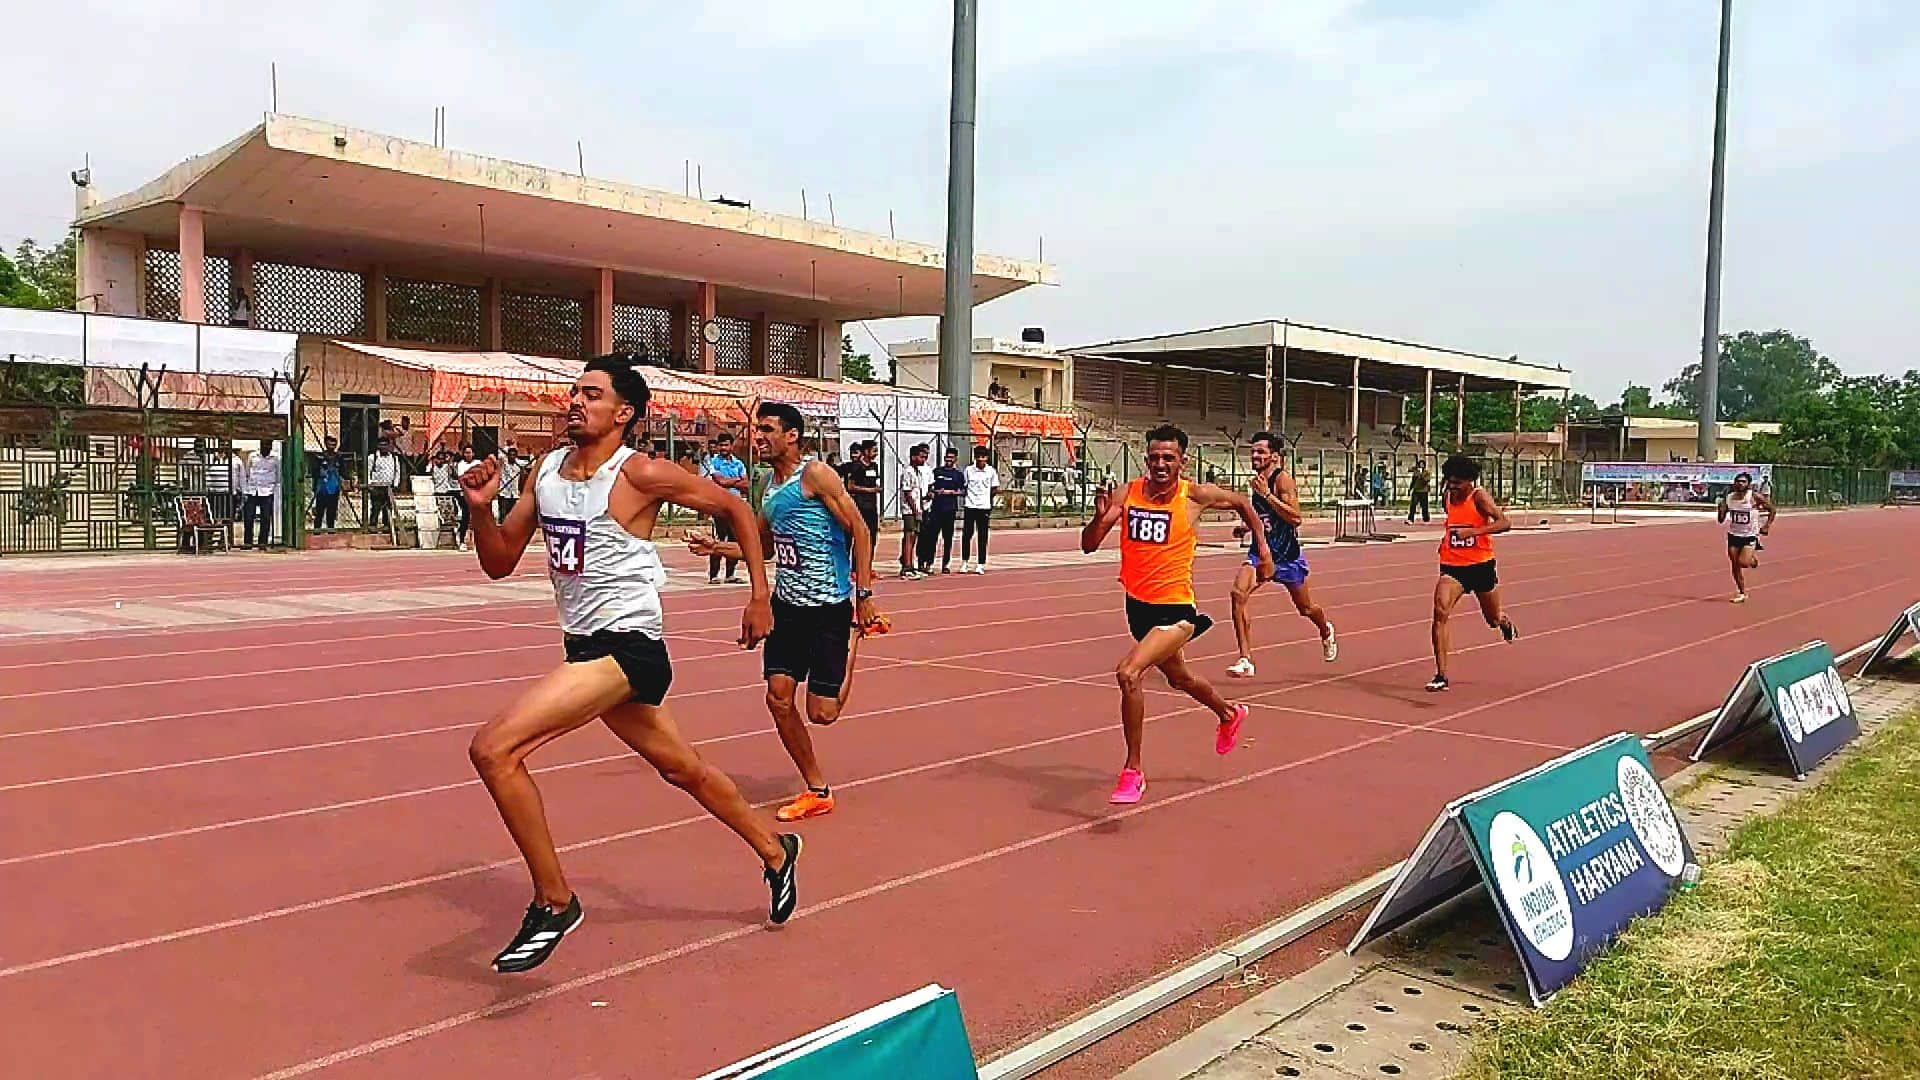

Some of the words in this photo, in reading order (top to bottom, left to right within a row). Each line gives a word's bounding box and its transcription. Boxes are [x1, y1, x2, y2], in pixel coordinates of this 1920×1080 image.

[1129, 518, 1167, 542] 188
[547, 536, 579, 571] 54
[778, 543, 797, 565] 93
[1545, 793, 1627, 860] ATHLETICS
[1570, 838, 1645, 904] HARYANA
